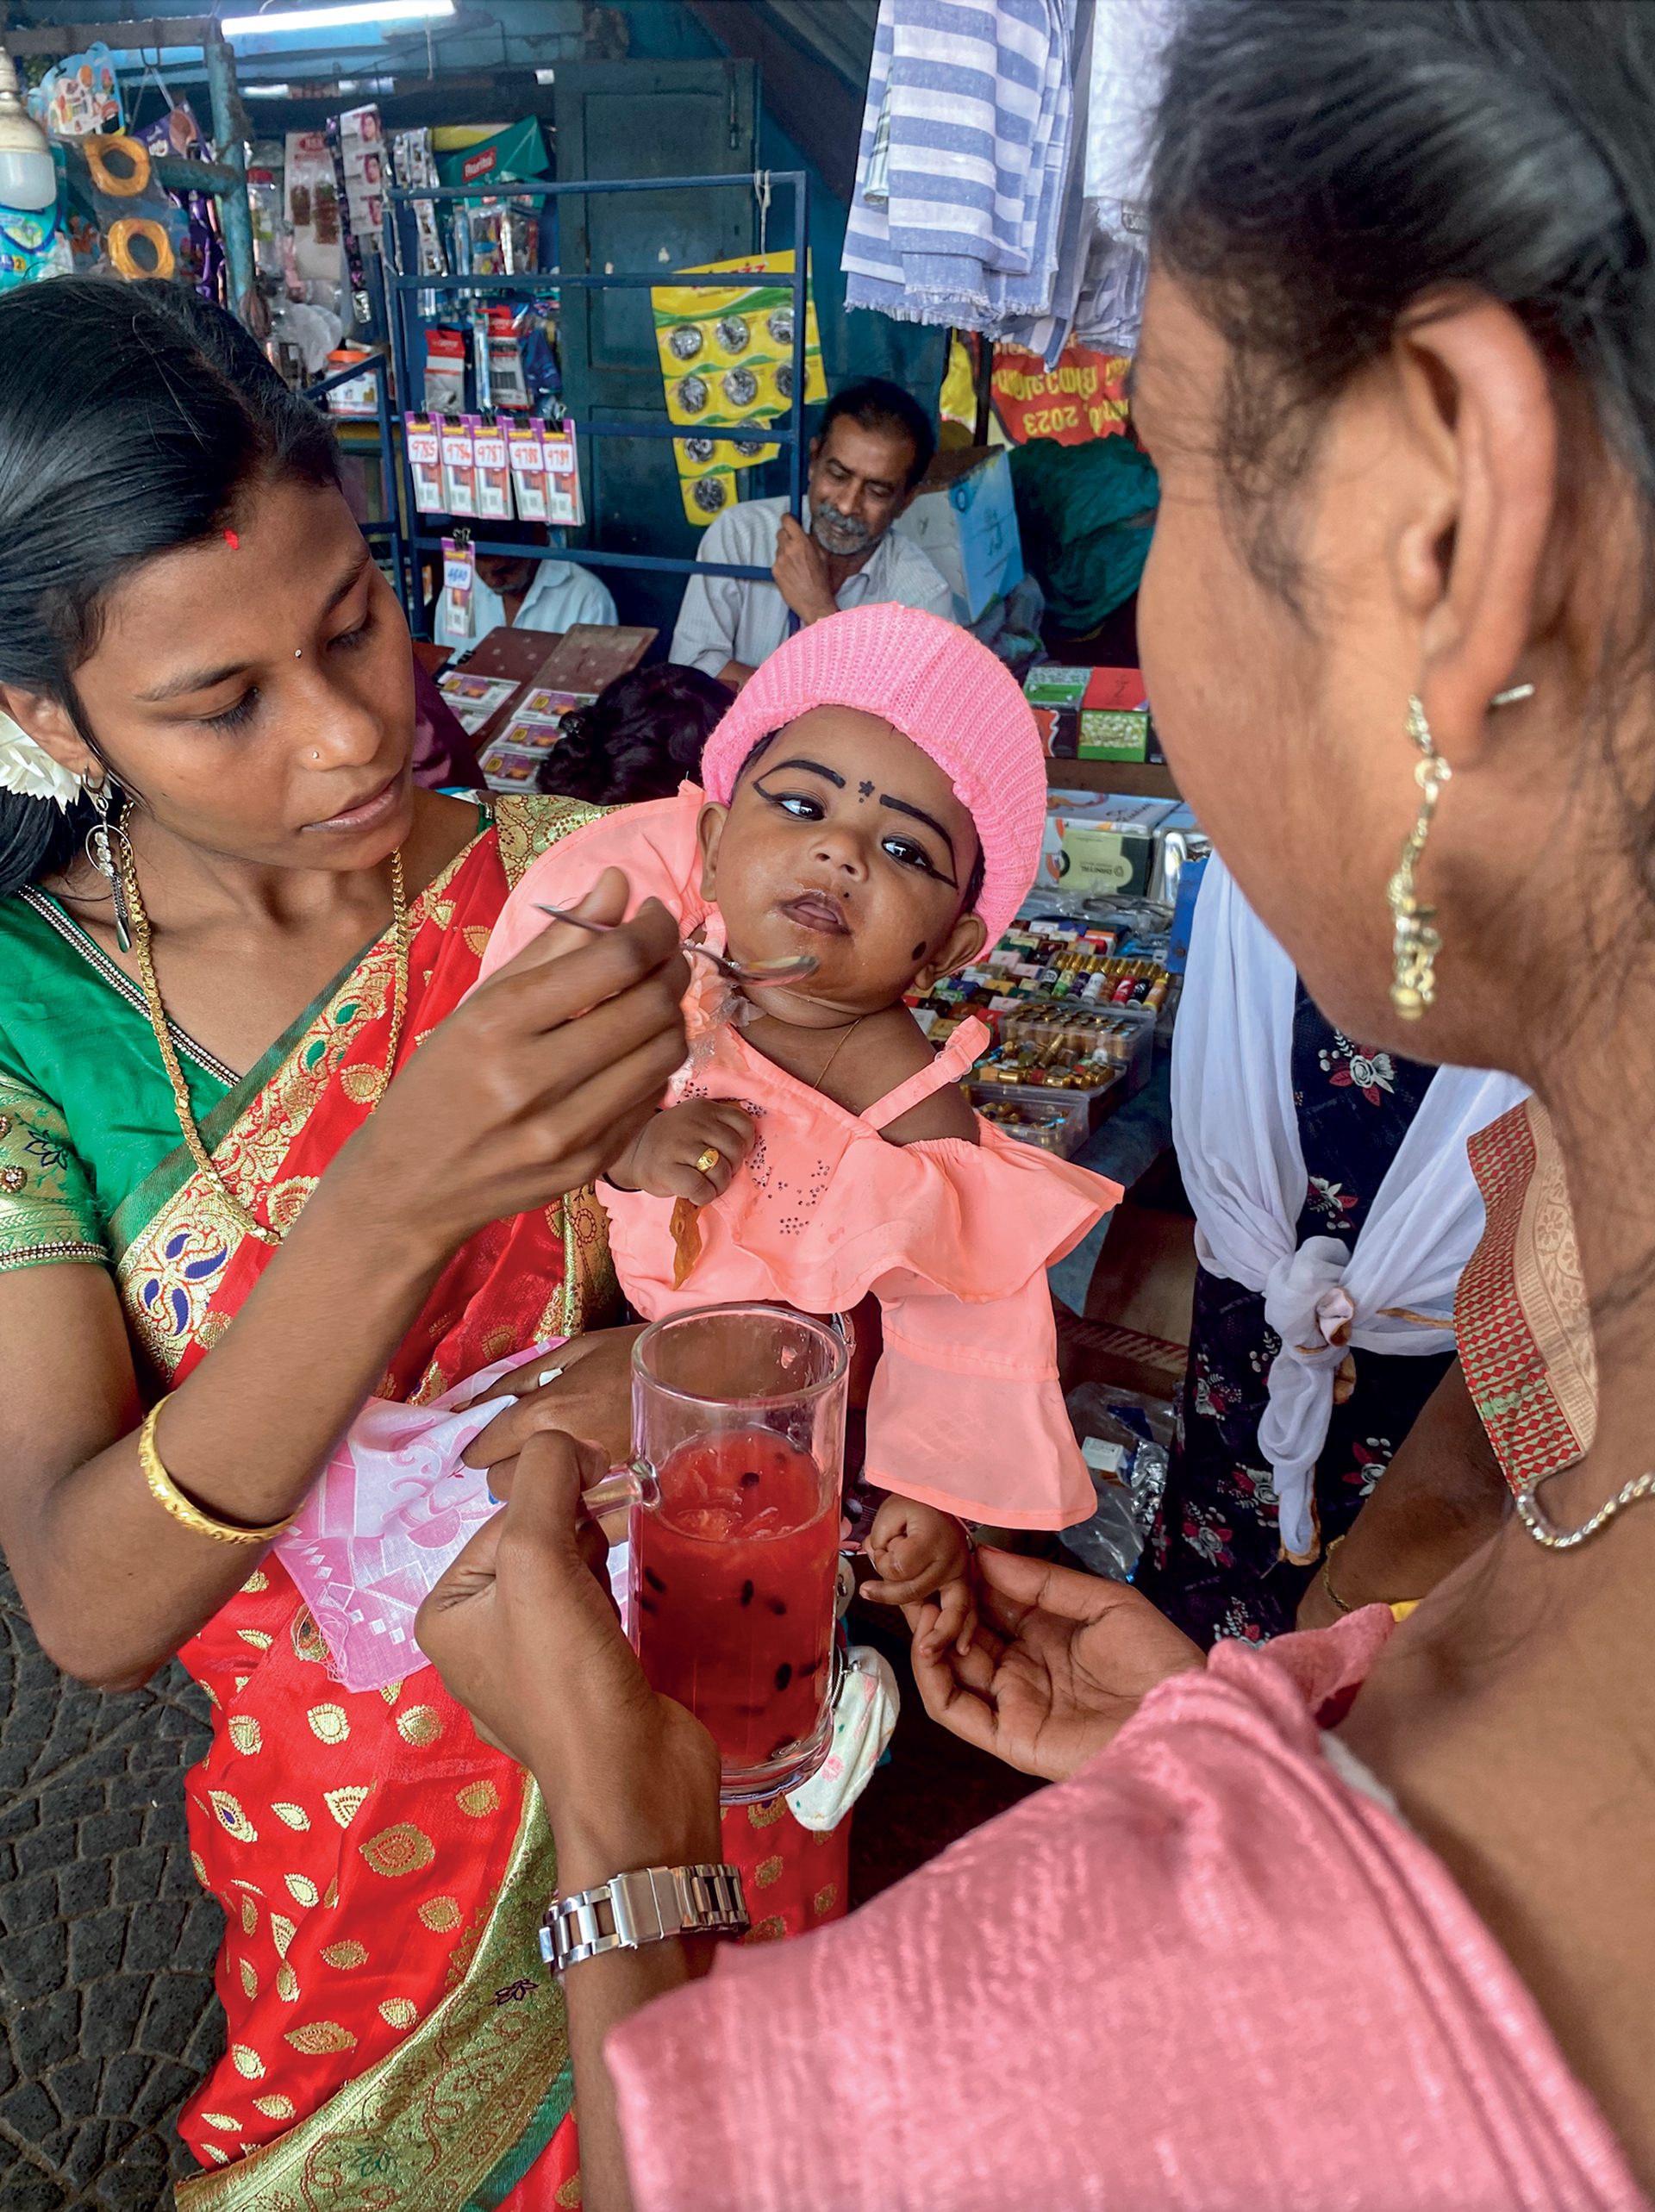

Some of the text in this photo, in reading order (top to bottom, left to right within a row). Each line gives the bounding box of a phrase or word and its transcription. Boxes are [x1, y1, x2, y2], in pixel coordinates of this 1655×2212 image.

[1022, 406, 1078, 435] 2023
[412, 441, 435, 458] 9785
[478, 445, 503, 463] 9787
